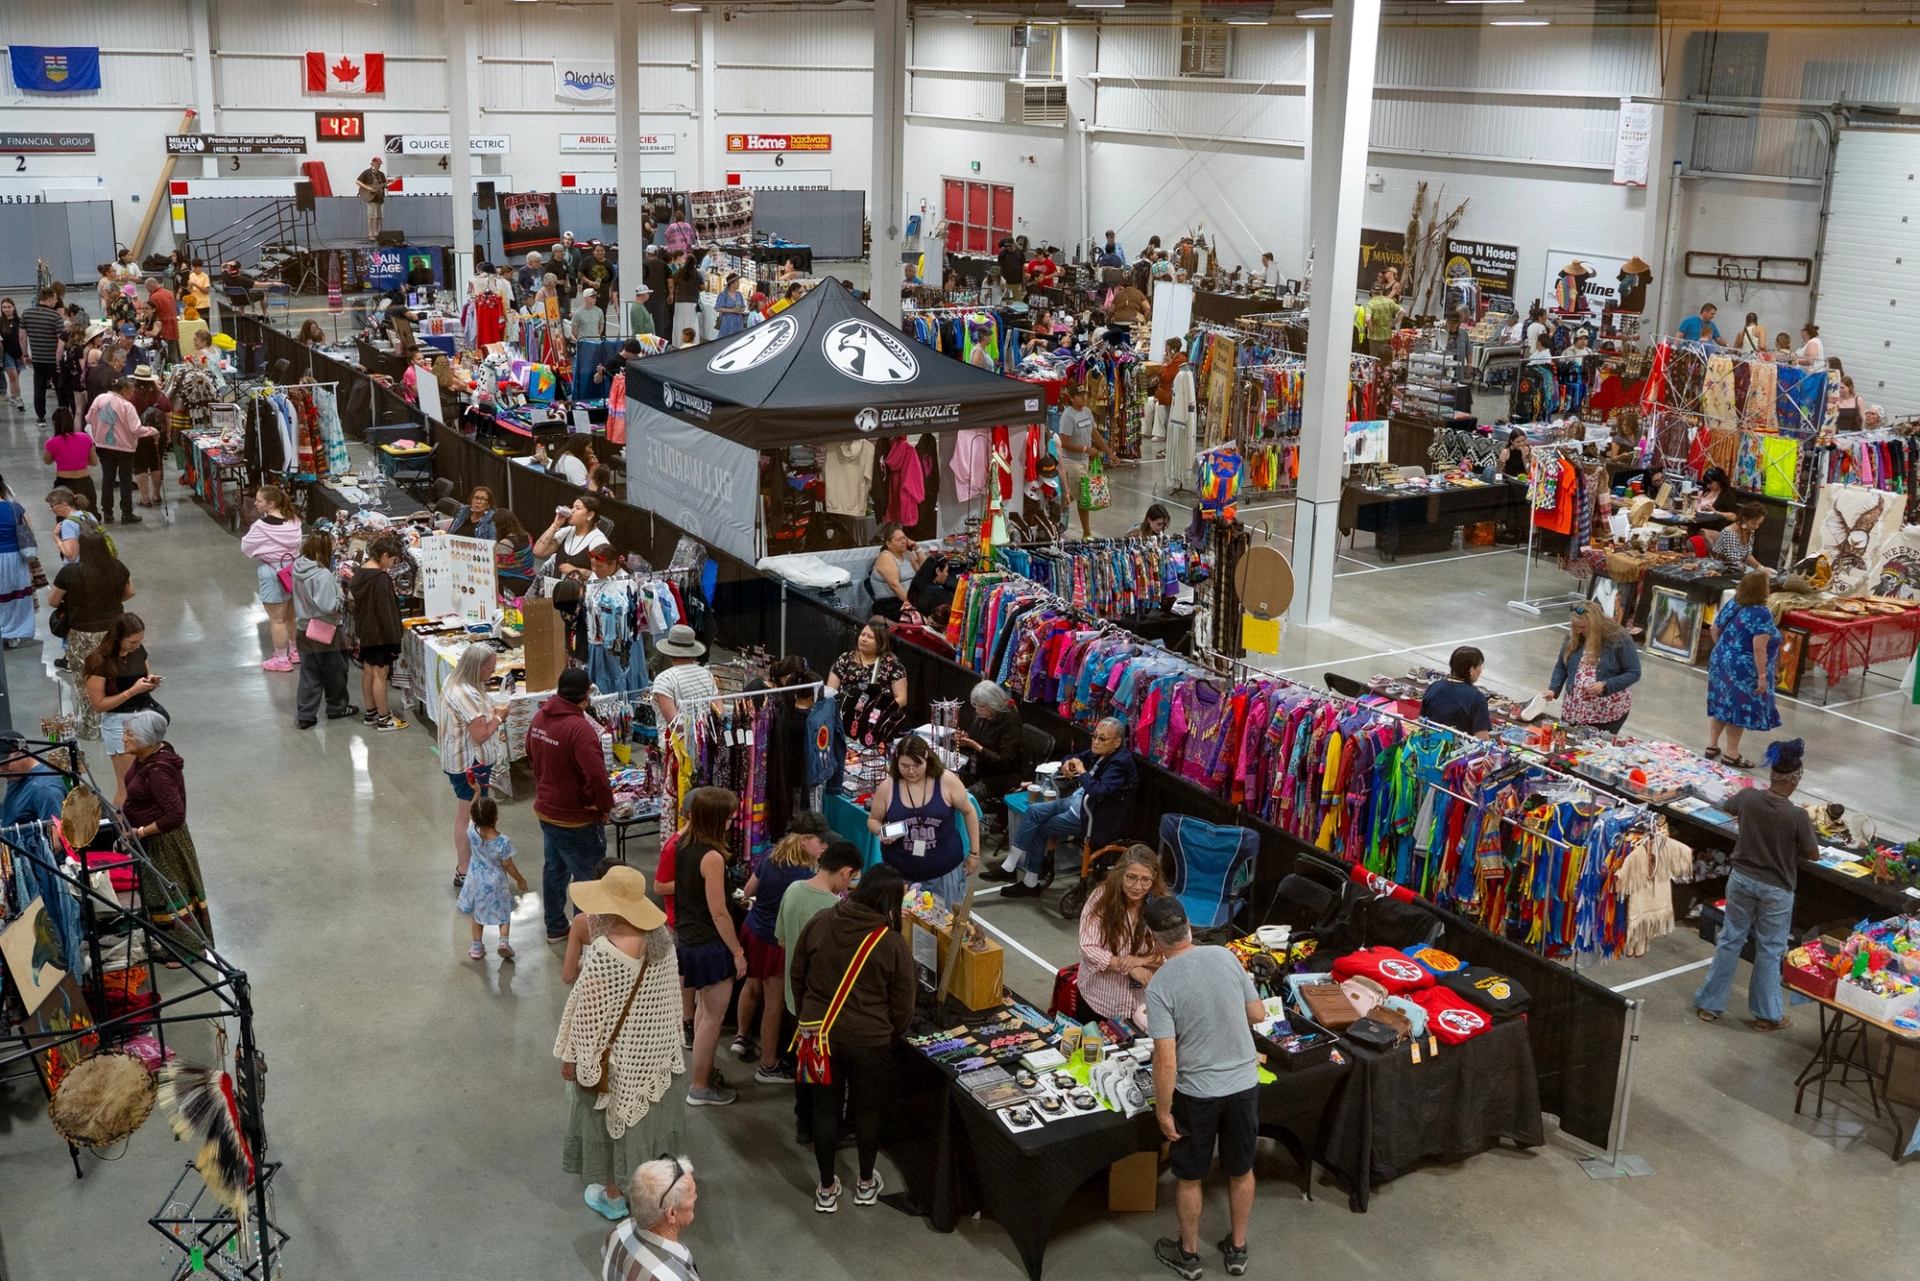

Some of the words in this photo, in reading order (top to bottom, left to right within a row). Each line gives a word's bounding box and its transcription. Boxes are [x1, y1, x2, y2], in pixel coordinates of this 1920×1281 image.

[565, 71, 614, 85] Okotoks
[8, 138, 54, 146] FINANCIAL
[60, 138, 90, 146] GROUP
[410, 140, 449, 149] QUIGLE
[470, 140, 504, 149] ECTRIC
[747, 136, 786, 149] Home
[16, 156, 26, 172] 2
[230, 156, 240, 171] 3
[438, 155, 448, 170] 4
[775, 153, 784, 166] 6
[7, 195, 12, 204] 5
[16, 195, 22, 204] 6
[26, 195, 30, 204] 7
[35, 195, 40, 204] 8
[1450, 242, 1473, 254] Guns
[1476, 245, 1483, 256] N
[1486, 246, 1516, 260] Hoses
[370, 264, 401, 273] STAGE
[674, 388, 712, 414] BILLWARDLIFE
[881, 404, 961, 421] BILLWARDLIFE
